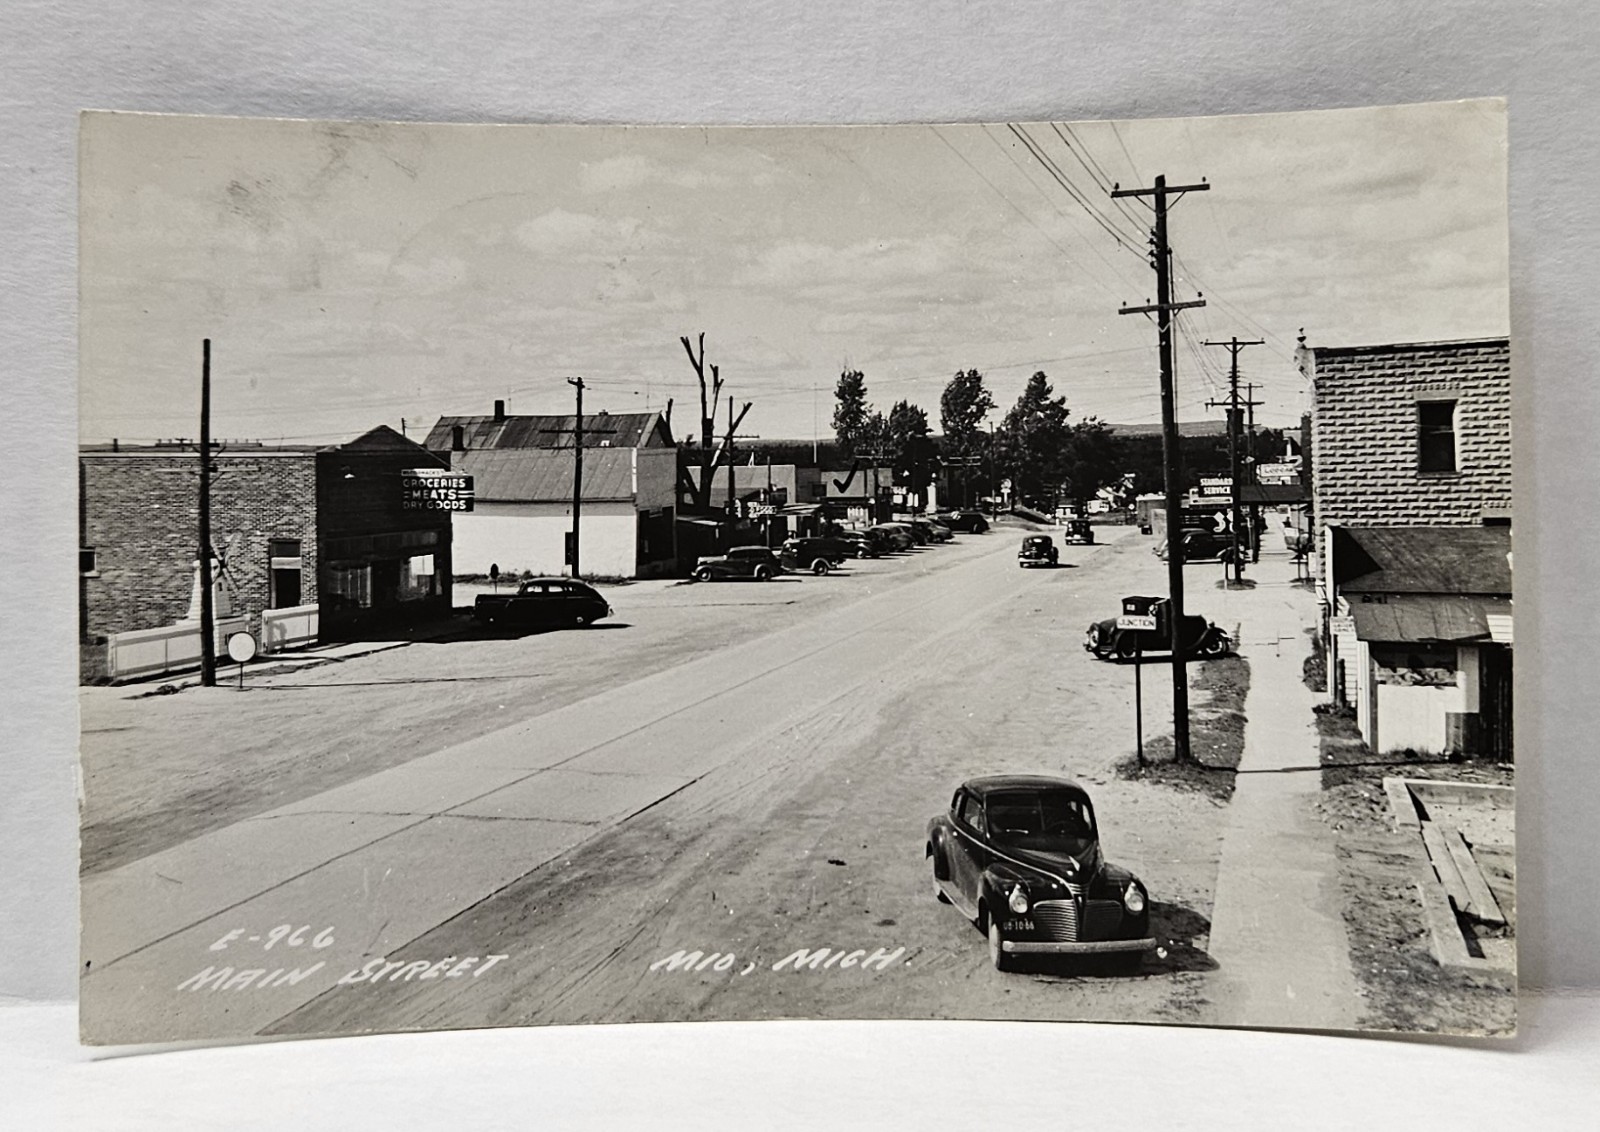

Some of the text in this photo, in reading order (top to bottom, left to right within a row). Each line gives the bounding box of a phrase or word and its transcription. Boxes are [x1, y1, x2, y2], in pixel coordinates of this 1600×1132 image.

[412, 489, 457, 500] MEATS
[1203, 486, 1231, 494] SERVICE
[403, 500, 466, 510] DRY GOODS
[1118, 618, 1155, 627] JUNCTION
